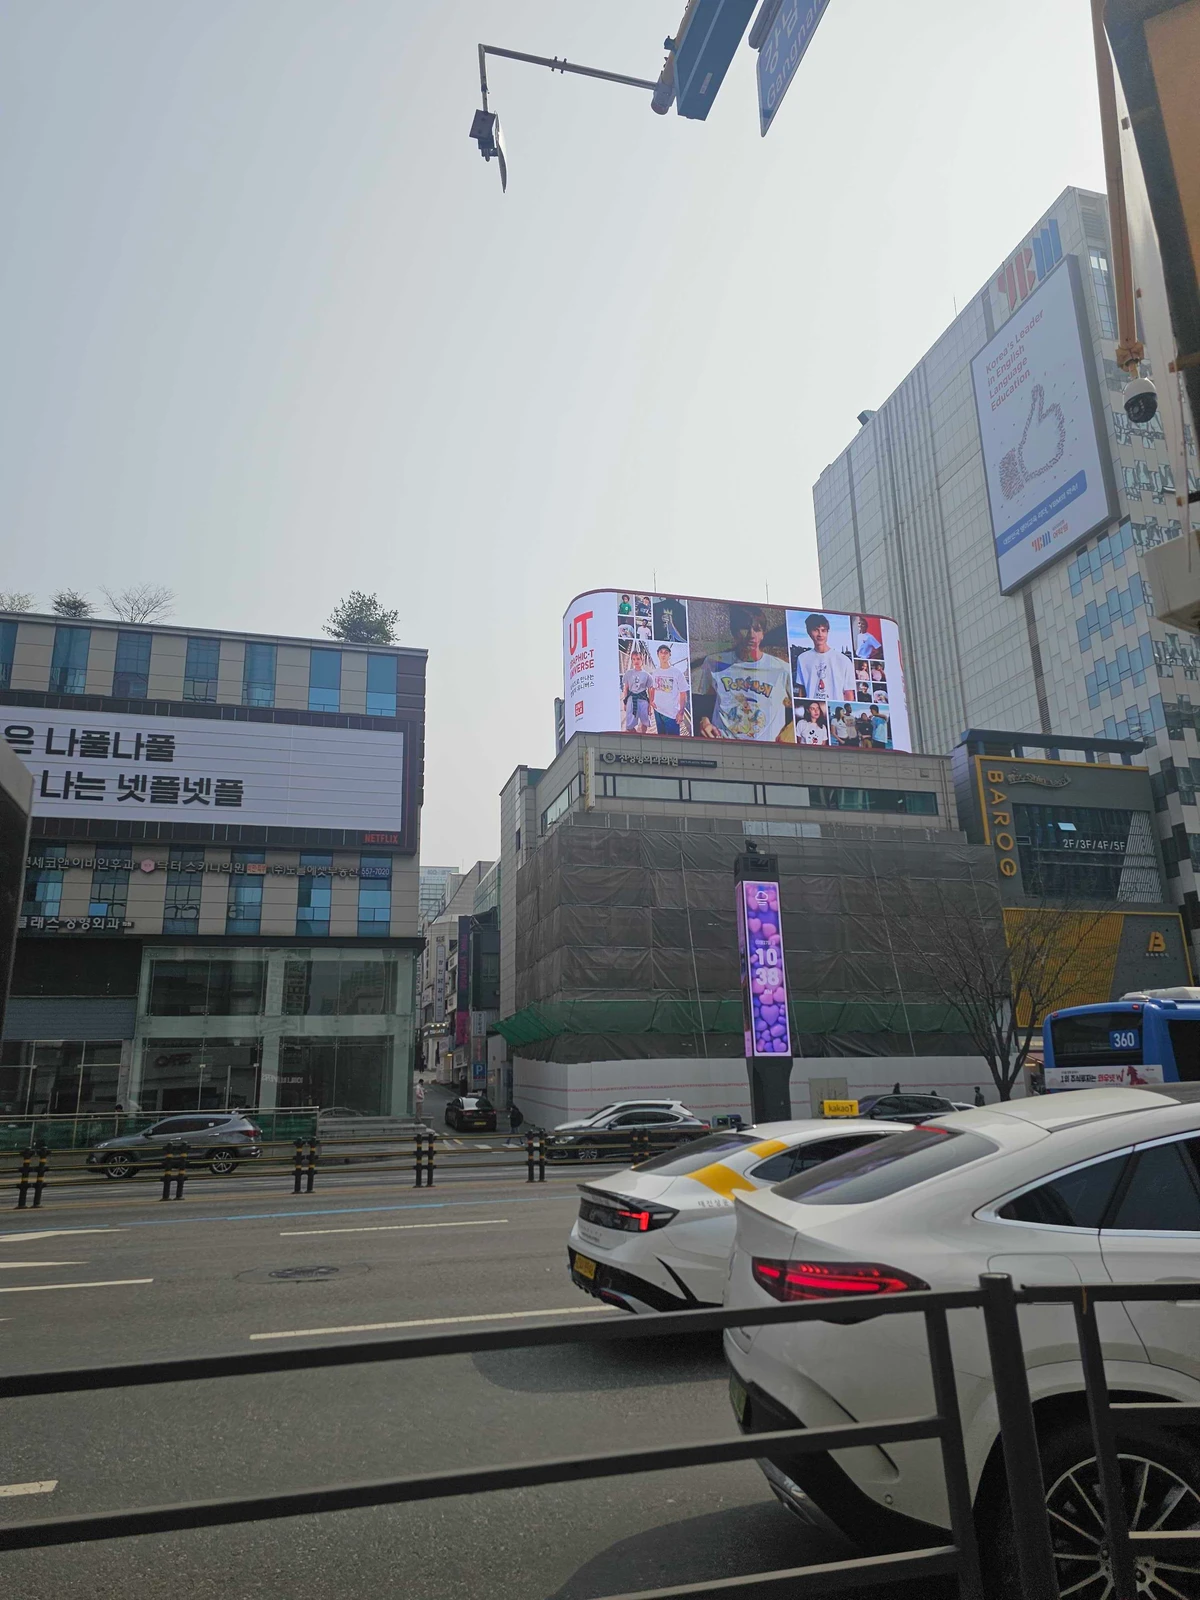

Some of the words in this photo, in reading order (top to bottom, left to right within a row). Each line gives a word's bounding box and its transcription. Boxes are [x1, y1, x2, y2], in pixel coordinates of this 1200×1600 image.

[997, 219, 1063, 311] YBM
[985, 341, 1014, 375] Korea's
[1015, 309, 1043, 344] Leader
[996, 344, 1025, 378] English
[989, 357, 1028, 399] Language
[990, 369, 1031, 412] Education
[569, 611, 593, 656] UT
[45, 728, 176, 762] 나풀나풀
[40, 770, 106, 801] 나는
[117, 774, 244, 807] 넷플넷플
[987, 770, 1017, 877] BAROG
[364, 834, 398, 844] NETFLIX
[1062, 838, 1126, 851] 2F/3F/4F/5F
[72, 857, 136, 870] 이비인후과
[157, 860, 181, 872] 닥터
[185, 862, 244, 874] 스키니의원
[65, 918, 120, 930] 성형외과
[756, 948, 778, 966] 10
[756, 968, 780, 986] 38
[1114, 1032, 1134, 1048] 360
[476, 1064, 483, 1075] P
